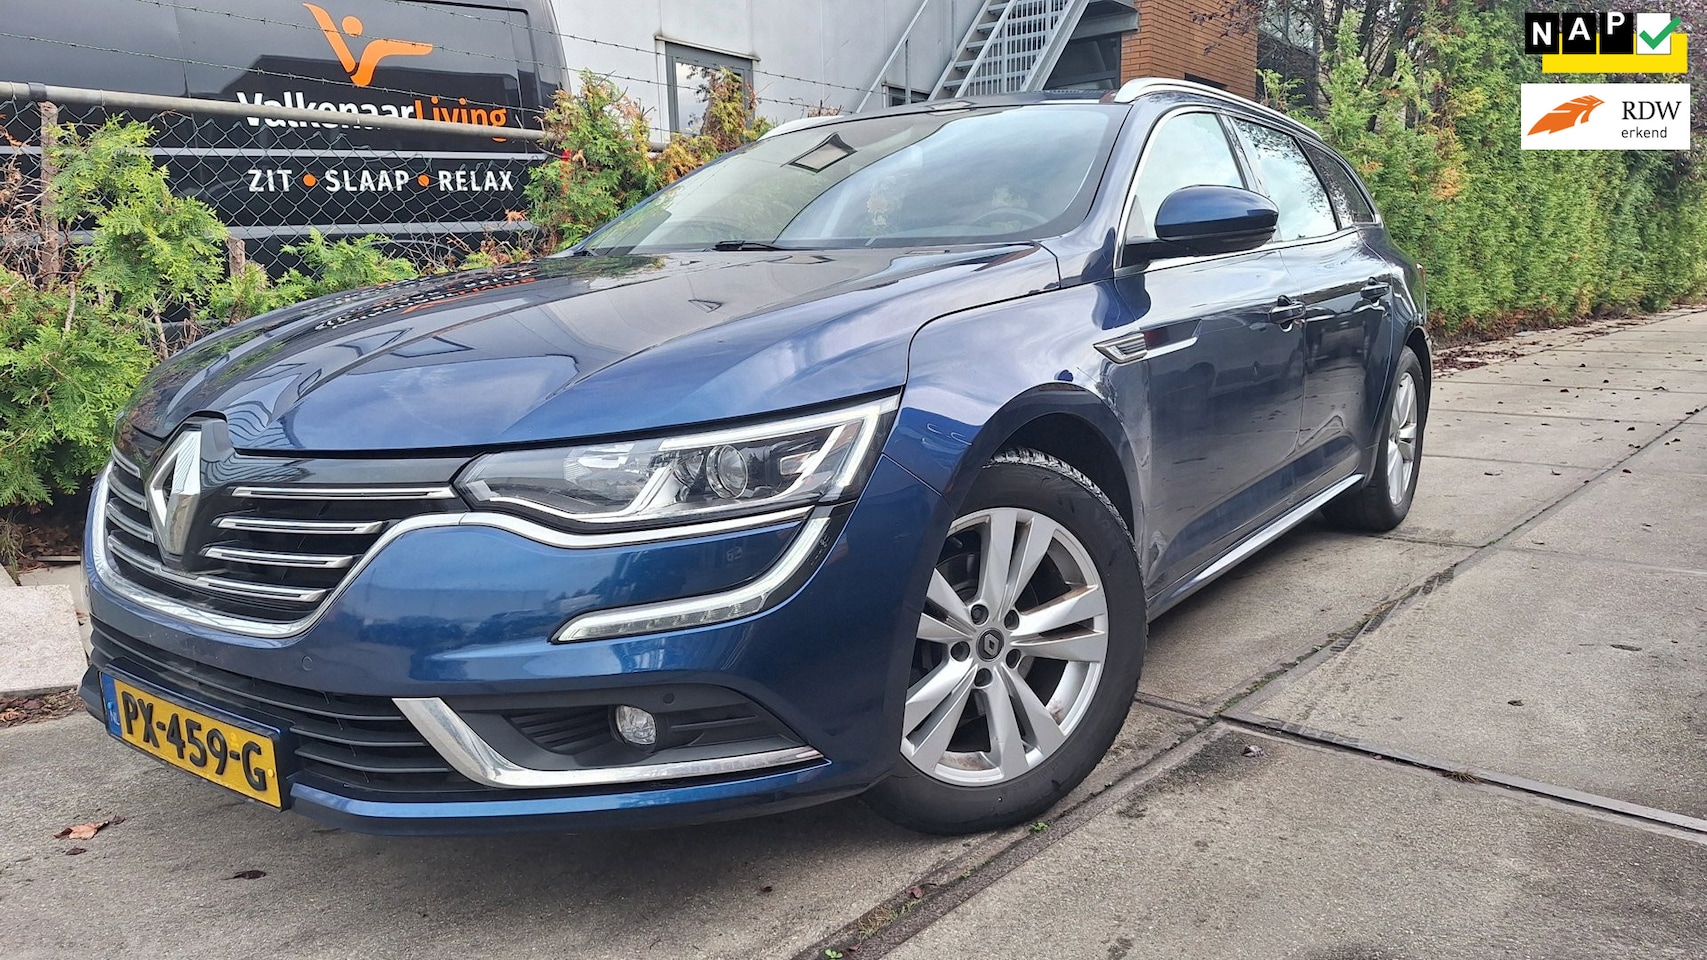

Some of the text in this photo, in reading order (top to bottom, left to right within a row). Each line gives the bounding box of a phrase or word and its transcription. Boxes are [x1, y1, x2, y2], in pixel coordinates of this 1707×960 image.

[248, 169, 514, 192] ZIT SLAAP RELAX
[121, 690, 268, 792] PX-459-G
